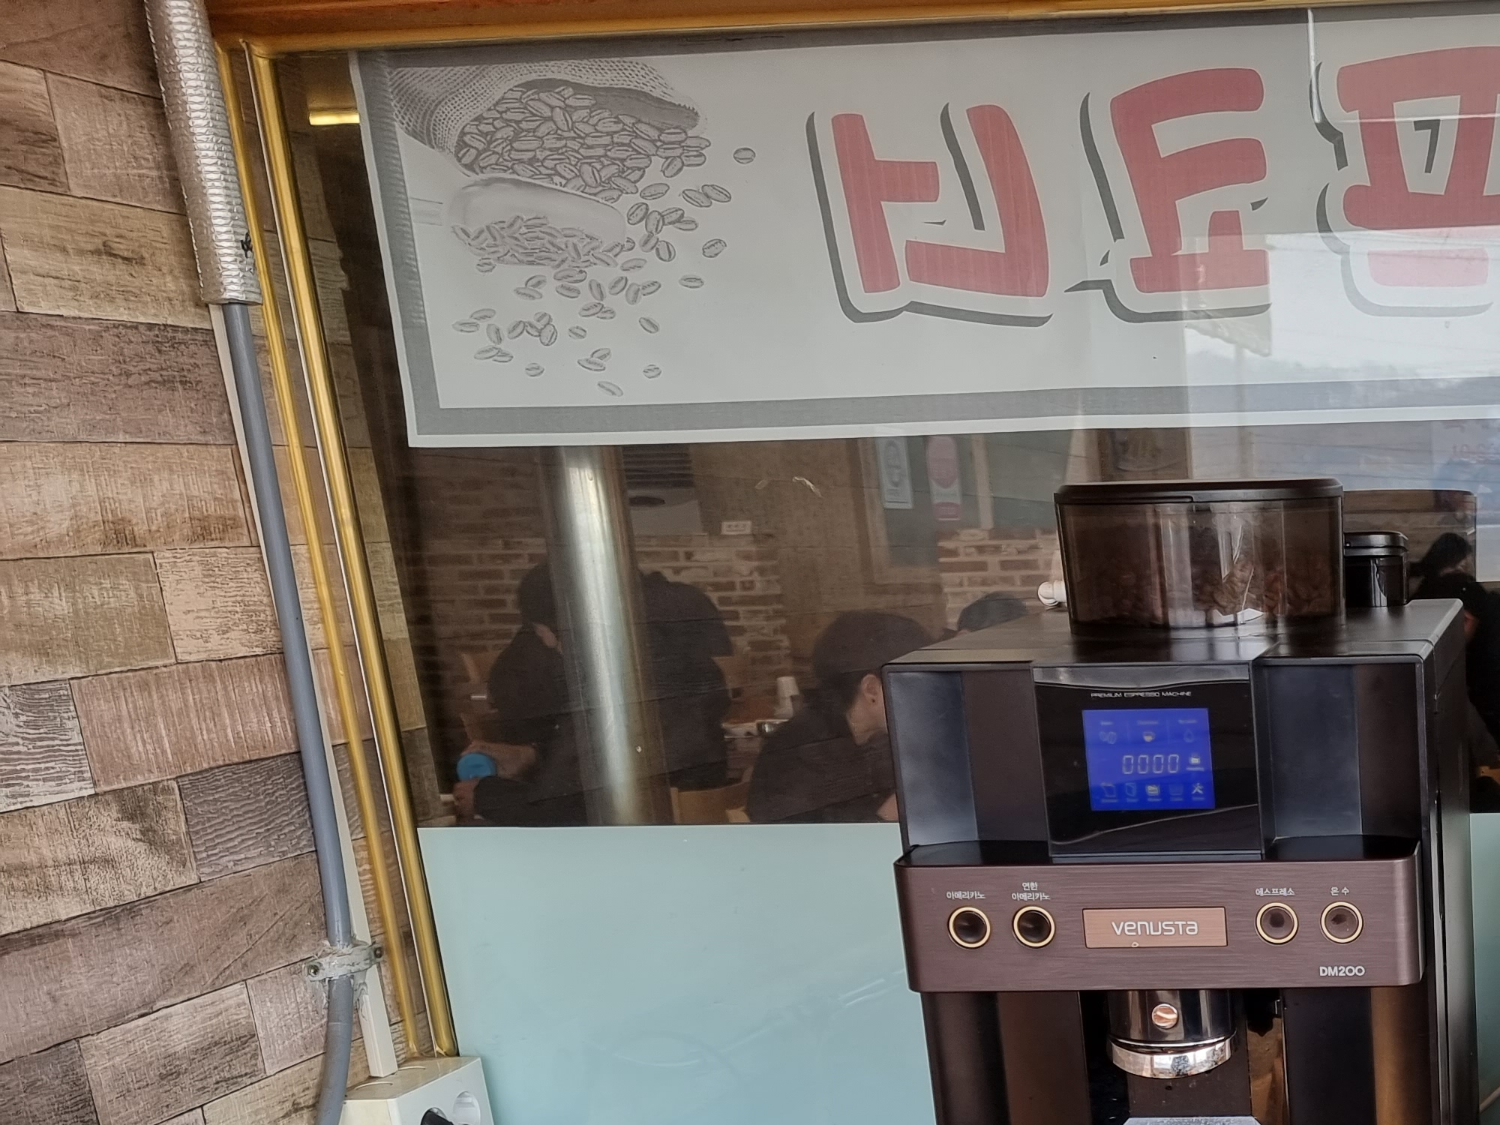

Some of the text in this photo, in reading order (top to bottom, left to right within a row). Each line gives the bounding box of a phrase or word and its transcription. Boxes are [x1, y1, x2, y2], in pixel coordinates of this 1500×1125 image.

[1122, 754, 1179, 774] 0000
[1021, 882, 1038, 891] 연한
[946, 890, 986, 900] 아메리카노
[1011, 891, 1051, 902] 아메리카노
[1255, 887, 1296, 897] 에스프레소
[1319, 965, 1366, 977] DM200
